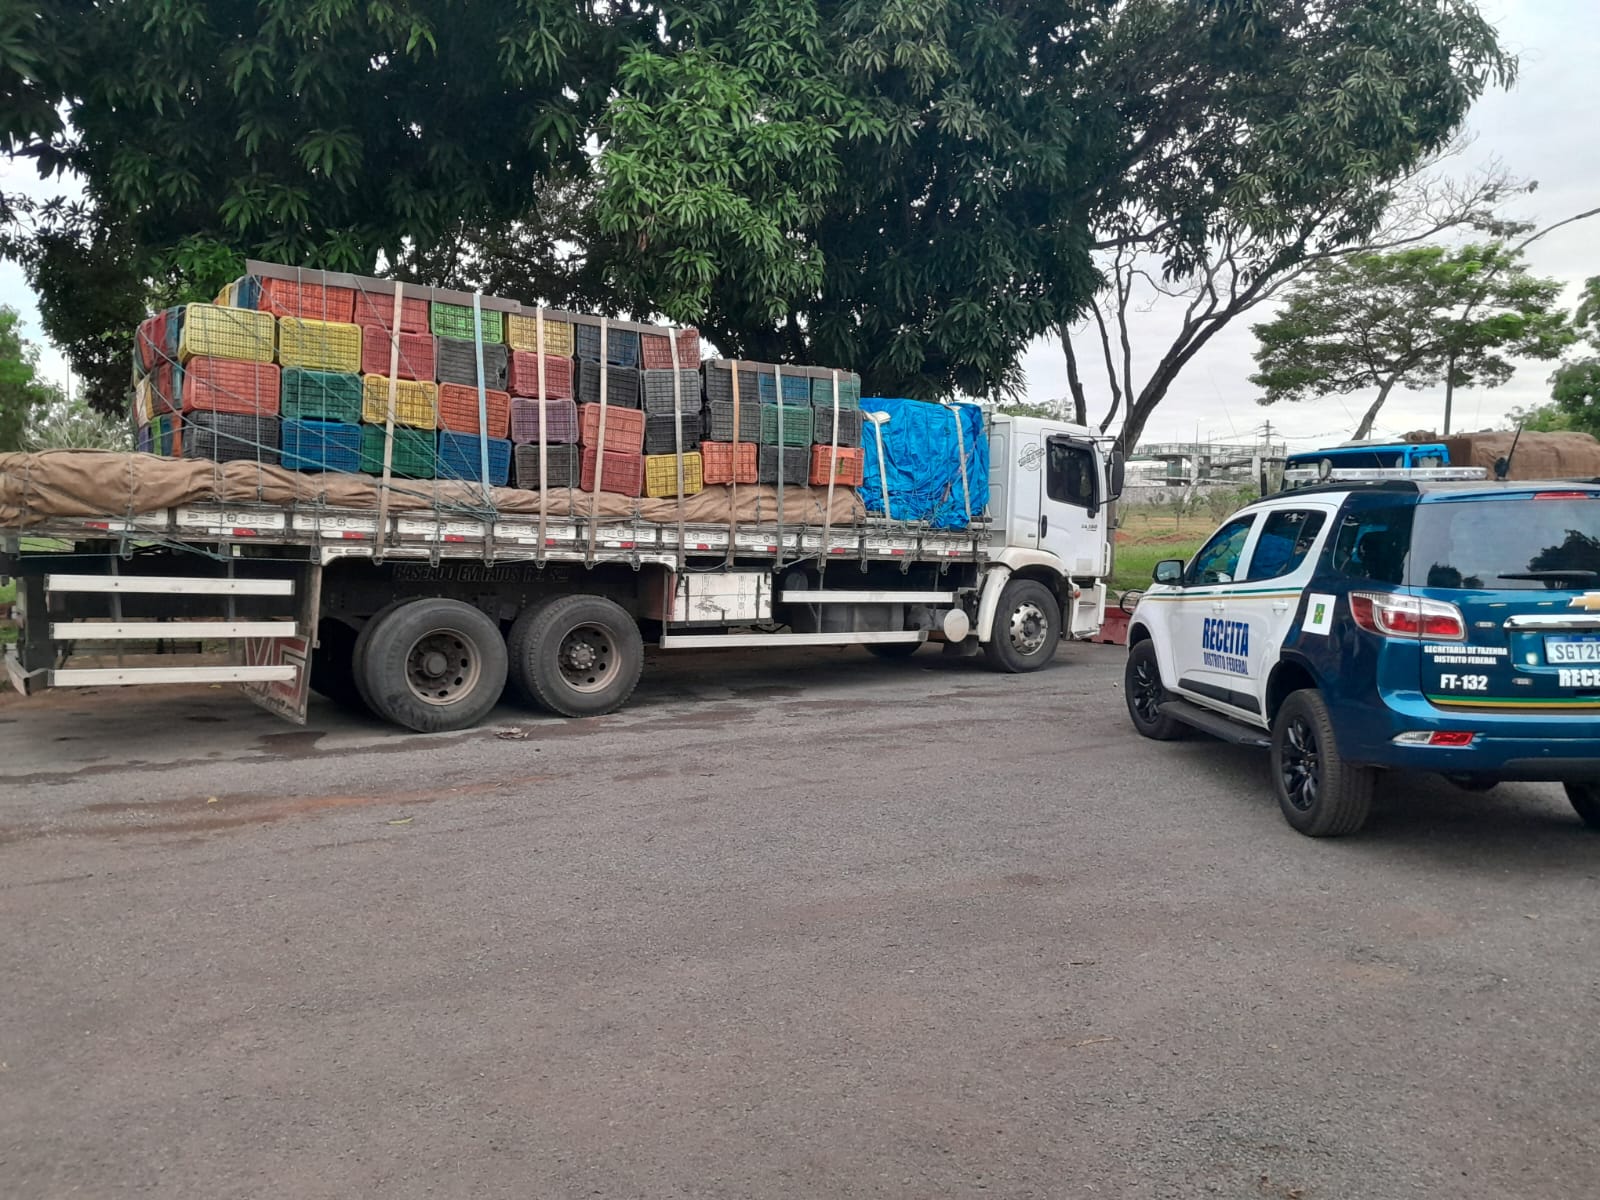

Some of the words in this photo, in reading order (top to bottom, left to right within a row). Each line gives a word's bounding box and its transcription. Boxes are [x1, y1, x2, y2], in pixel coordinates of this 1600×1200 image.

[1202, 617, 1249, 658] RECEITA
[1423, 645, 1466, 654] SECRETARIA
[1467, 646, 1477, 655] DE
[1477, 646, 1508, 656] FAZENDA
[1203, 651, 1226, 670] DISTRITO
[1226, 656, 1249, 675] FEDERAL
[1433, 655, 1467, 664] DISTRITO
[1467, 656, 1497, 665] FEDERAL
[1440, 673, 1489, 691] FT-132
